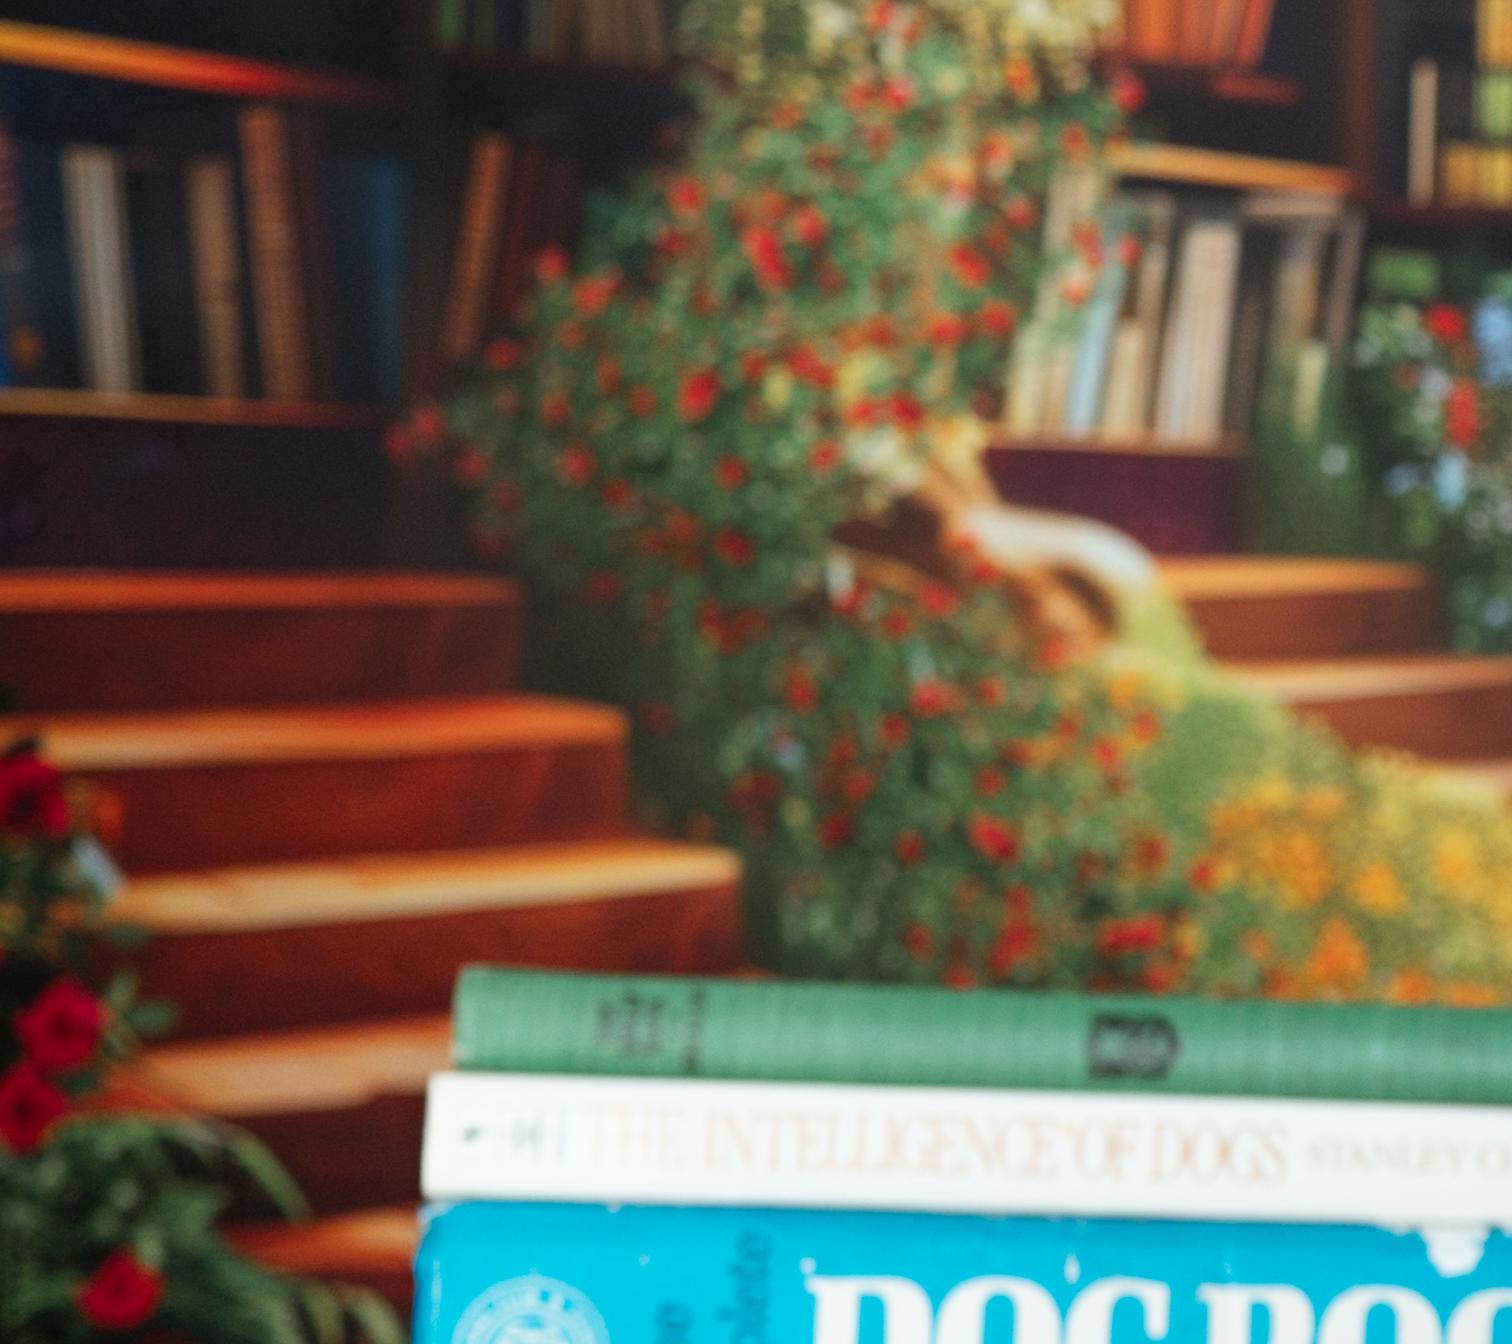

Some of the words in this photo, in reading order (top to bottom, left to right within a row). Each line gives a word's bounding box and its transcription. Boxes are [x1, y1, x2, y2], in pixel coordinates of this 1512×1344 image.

[586, 1102, 686, 1170] THE
[702, 1105, 1051, 1178] INTELLIGENCE
[1071, 1113, 1140, 1181] OF
[1150, 1116, 1289, 1184] DOGS
